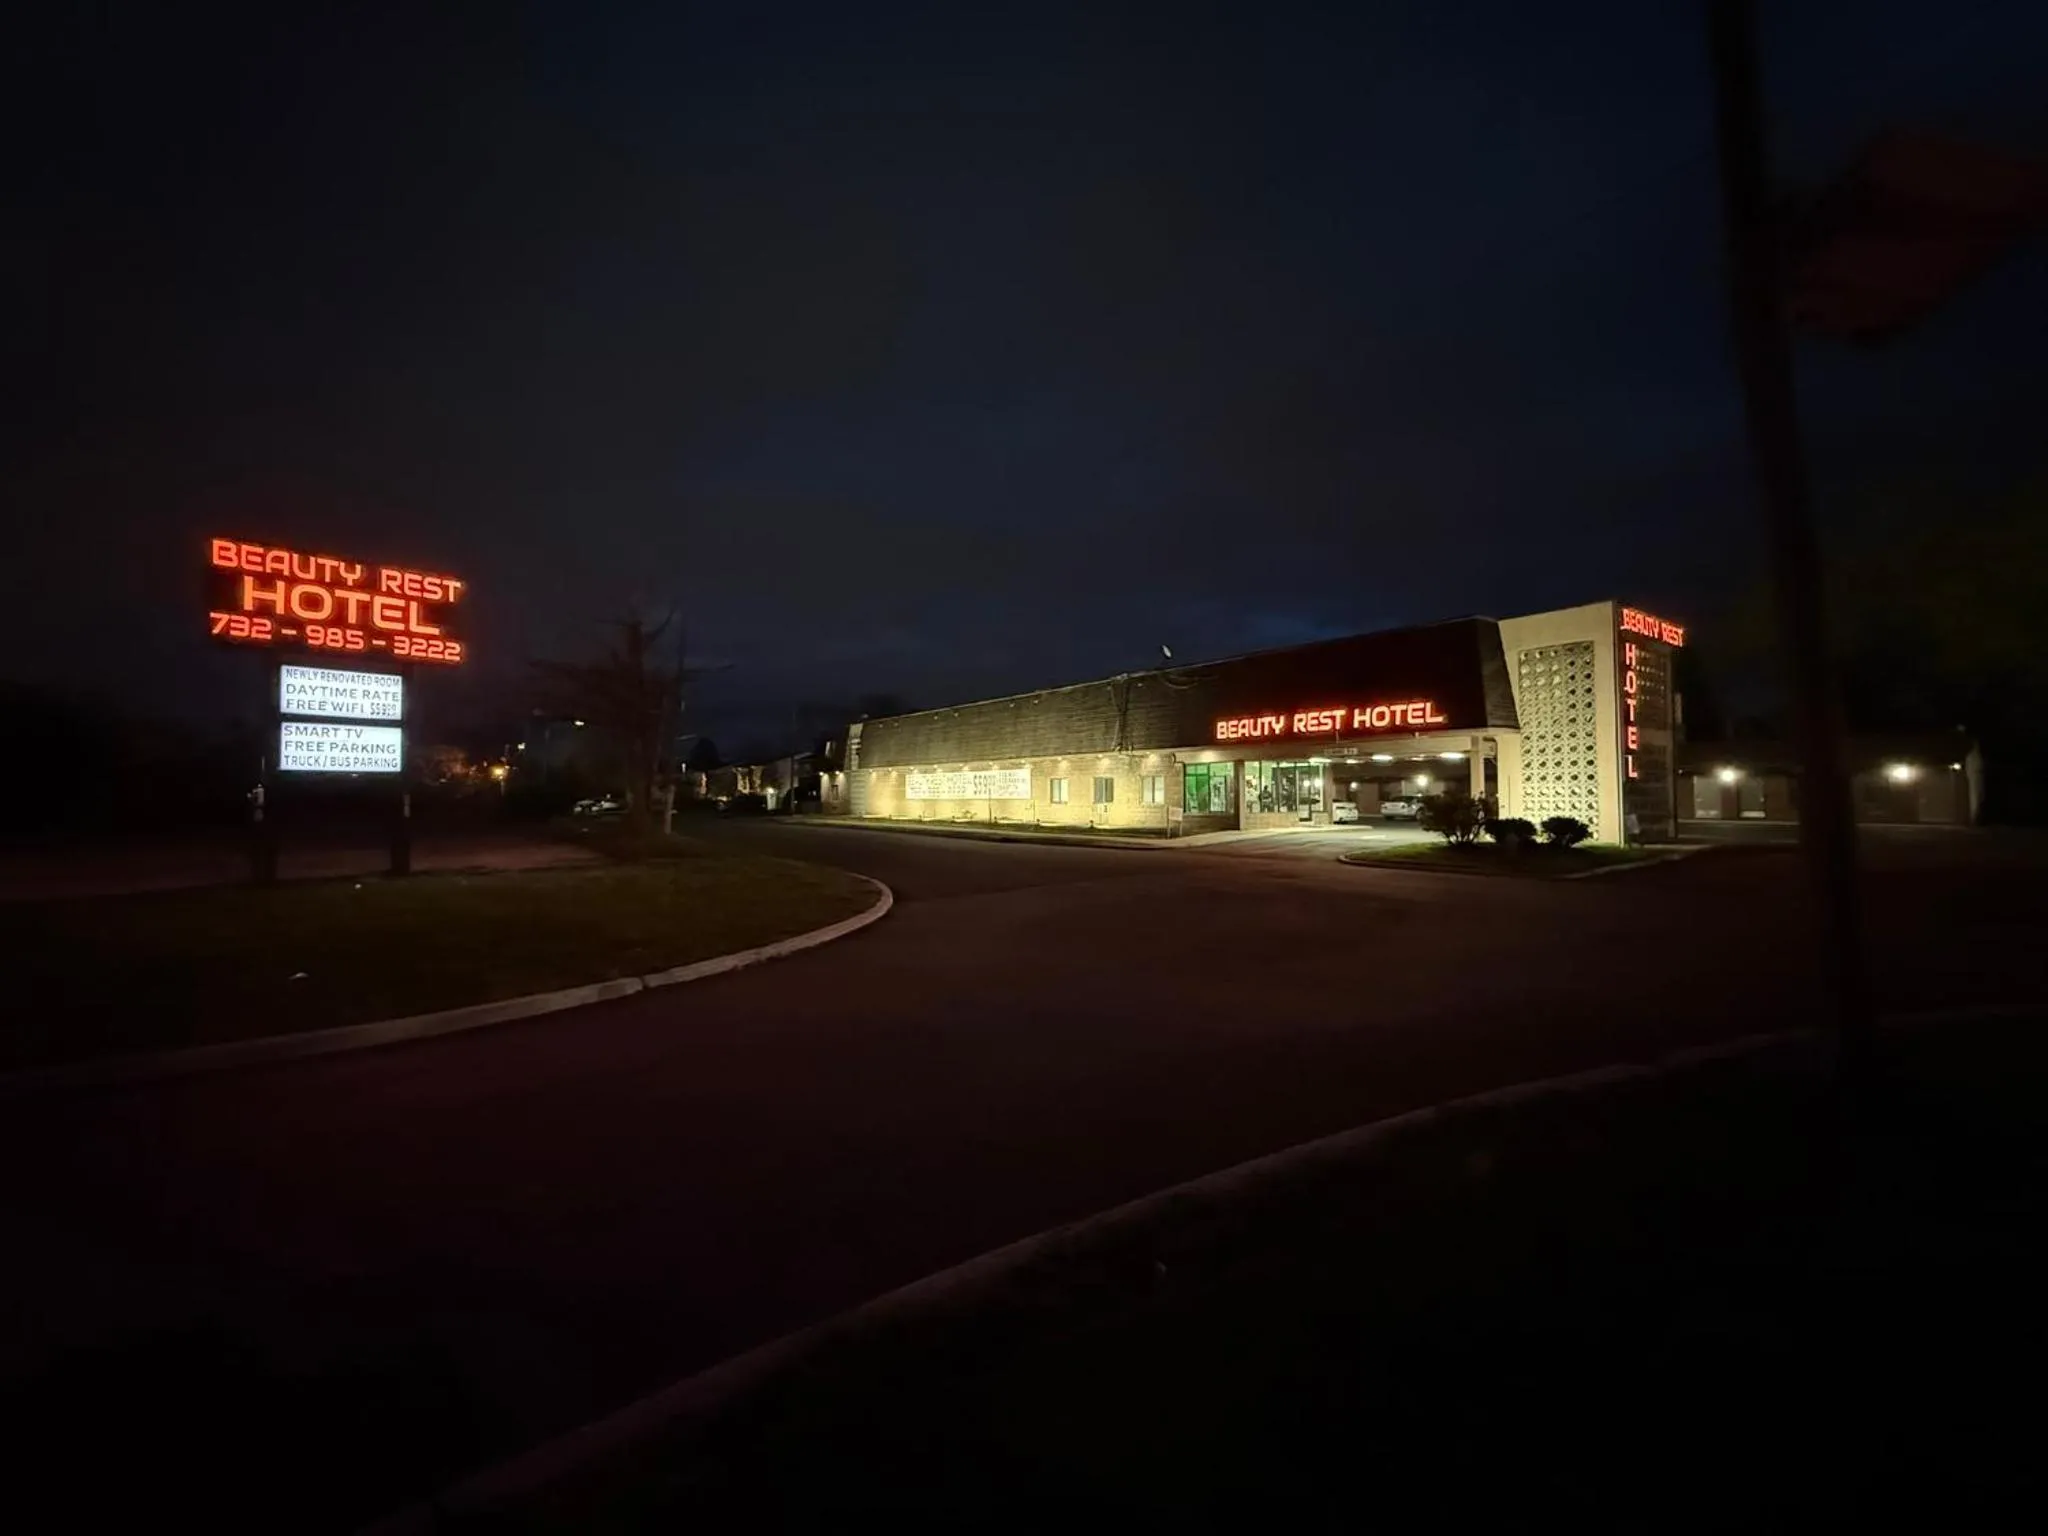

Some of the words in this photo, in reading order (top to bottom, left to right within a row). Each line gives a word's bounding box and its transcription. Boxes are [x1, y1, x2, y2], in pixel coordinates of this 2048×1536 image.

[212, 539, 361, 586] BEAUTY
[381, 568, 462, 602] REST
[242, 575, 441, 635] HOTEL
[1621, 608, 1659, 639] BEAUTY
[1662, 622, 1684, 647] REST
[286, 668, 319, 681] NEWLY
[320, 672, 372, 686] RENOVATED
[286, 684, 357, 699] DAYTIME
[362, 688, 400, 702] RATE
[285, 699, 327, 711] FREE
[331, 701, 365, 714] WIFI
[1625, 643, 1640, 777] HOTEL
[1216, 715, 1285, 740] BEAUTY
[1293, 709, 1347, 733] REST
[1353, 701, 1444, 729] HOTEL
[283, 725, 341, 738] SMART
[343, 728, 364, 739] TV
[284, 740, 325, 752] FREE
[329, 742, 396, 754] PARKING
[284, 755, 321, 768] TRUCK
[330, 756, 352, 768] BUS
[353, 757, 398, 769] PARKING
